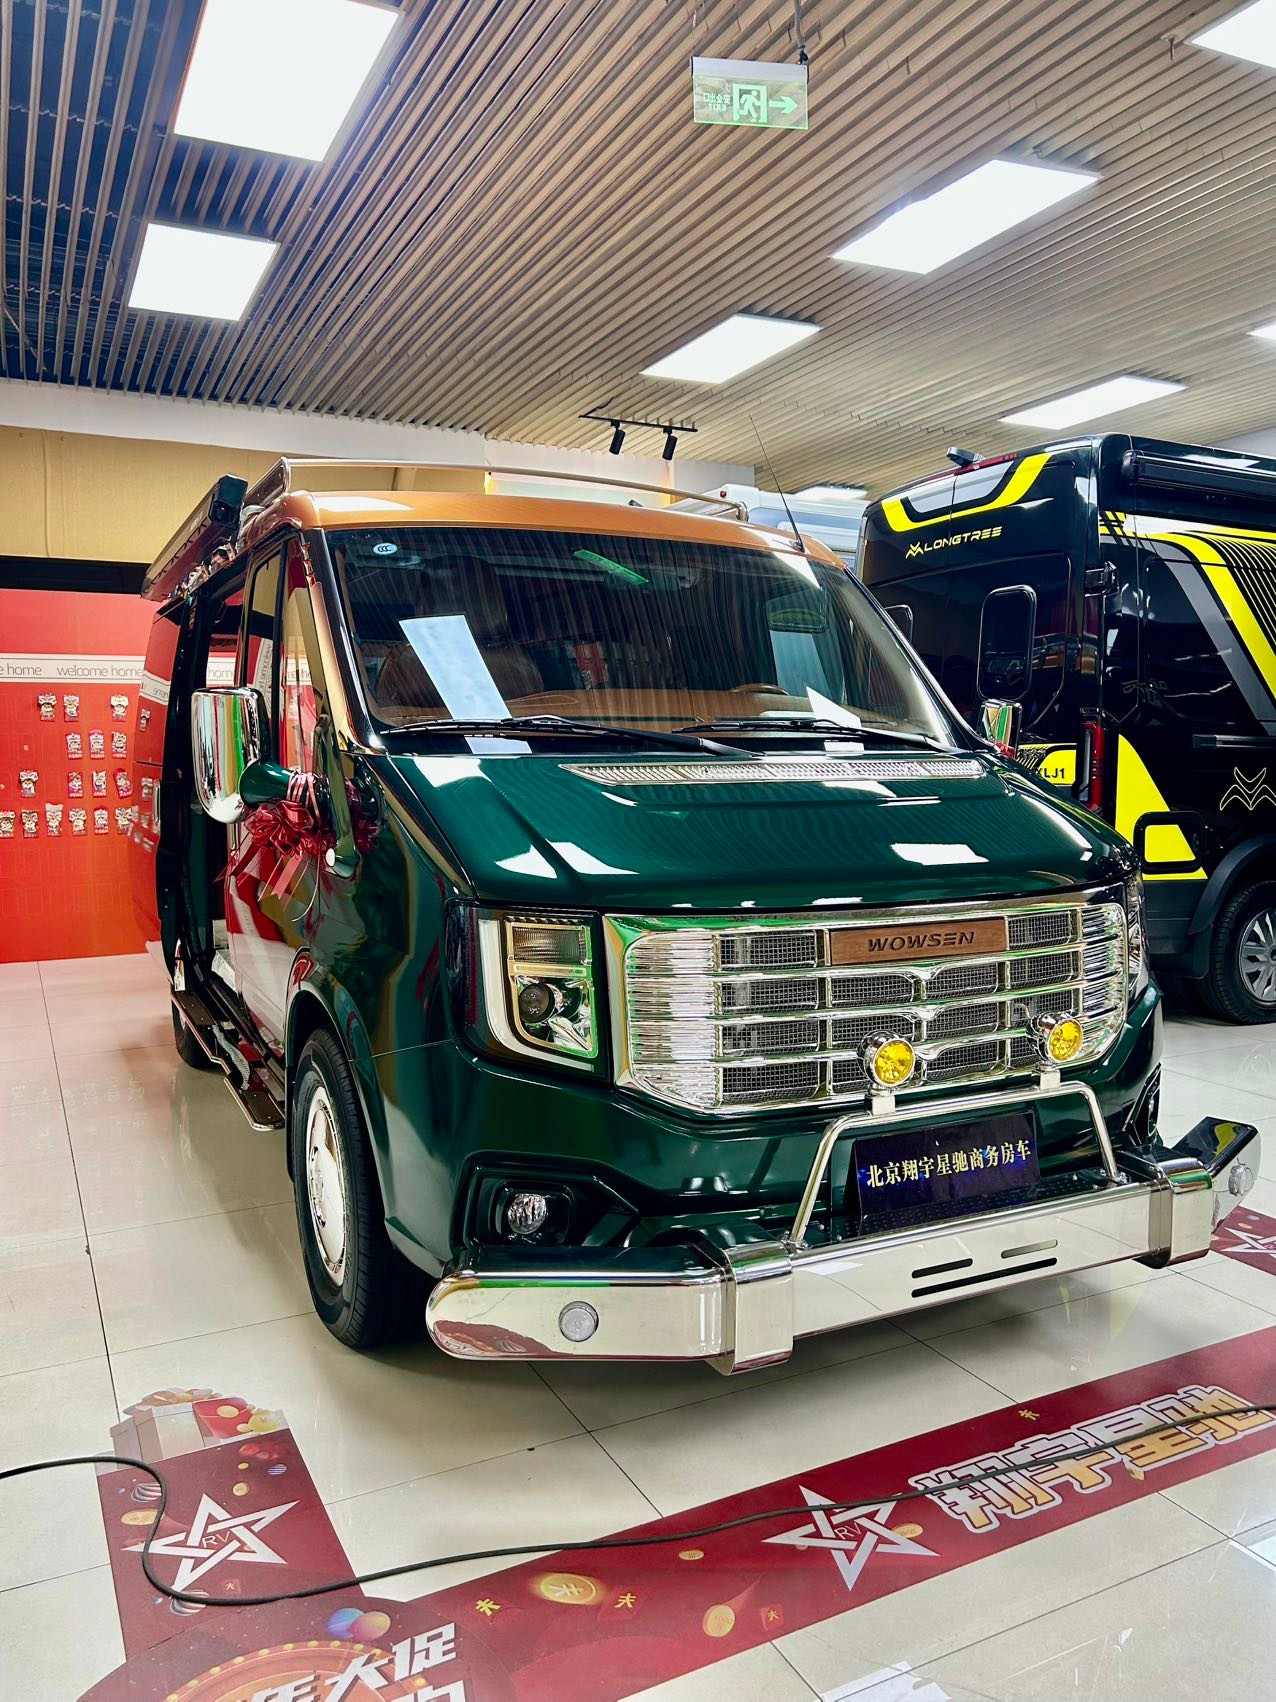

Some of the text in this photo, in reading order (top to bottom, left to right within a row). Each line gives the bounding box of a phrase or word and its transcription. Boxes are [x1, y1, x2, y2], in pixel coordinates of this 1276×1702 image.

[923, 526, 1003, 552] LONGTREE
[7, 663, 42, 676] home
[57, 664, 144, 678] welcome home
[867, 931, 975, 953] WOWSEN
[866, 1139, 1032, 1189] 北京翔宇星驰商务房车
[909, 1385, 1276, 1533] 翔宇星驰
[201, 1529, 231, 1549] RV
[834, 1522, 863, 1541] RV
